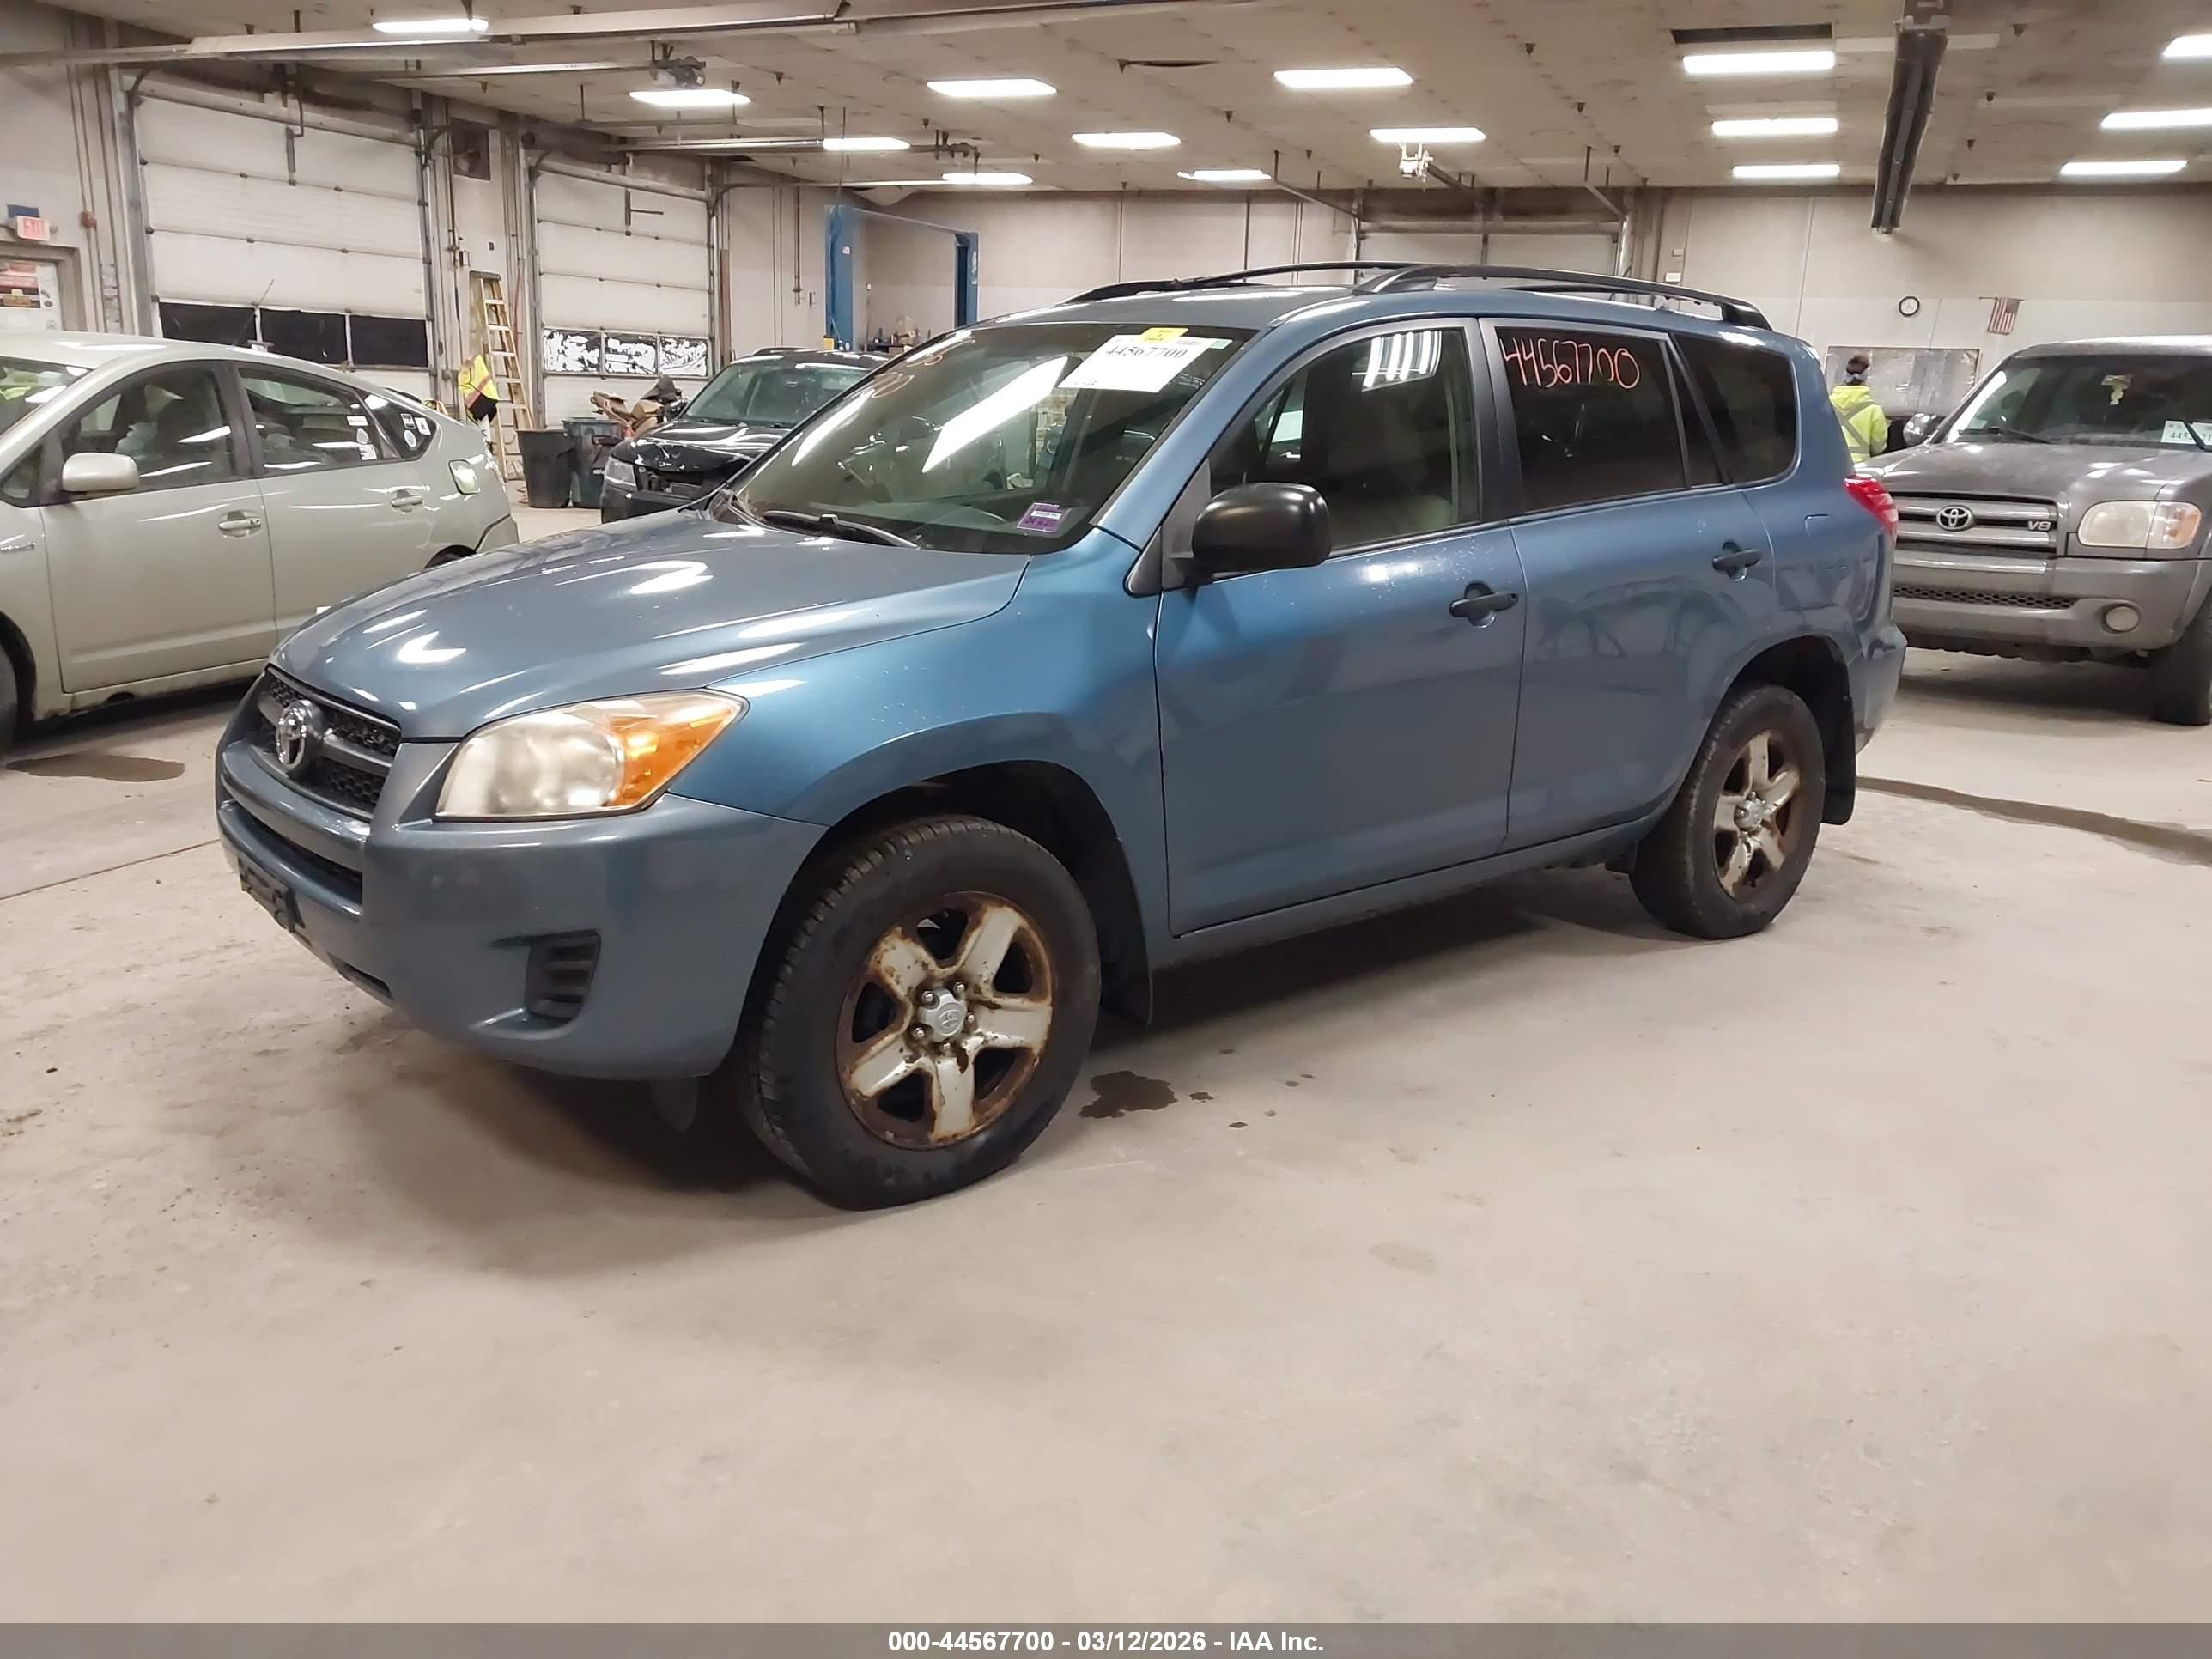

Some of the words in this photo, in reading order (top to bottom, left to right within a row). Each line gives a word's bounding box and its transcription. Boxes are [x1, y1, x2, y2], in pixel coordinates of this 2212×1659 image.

[1105, 346, 1188, 359] 44567700
[1499, 337, 1640, 389] 44567700
[2027, 520, 2052, 531] V8
